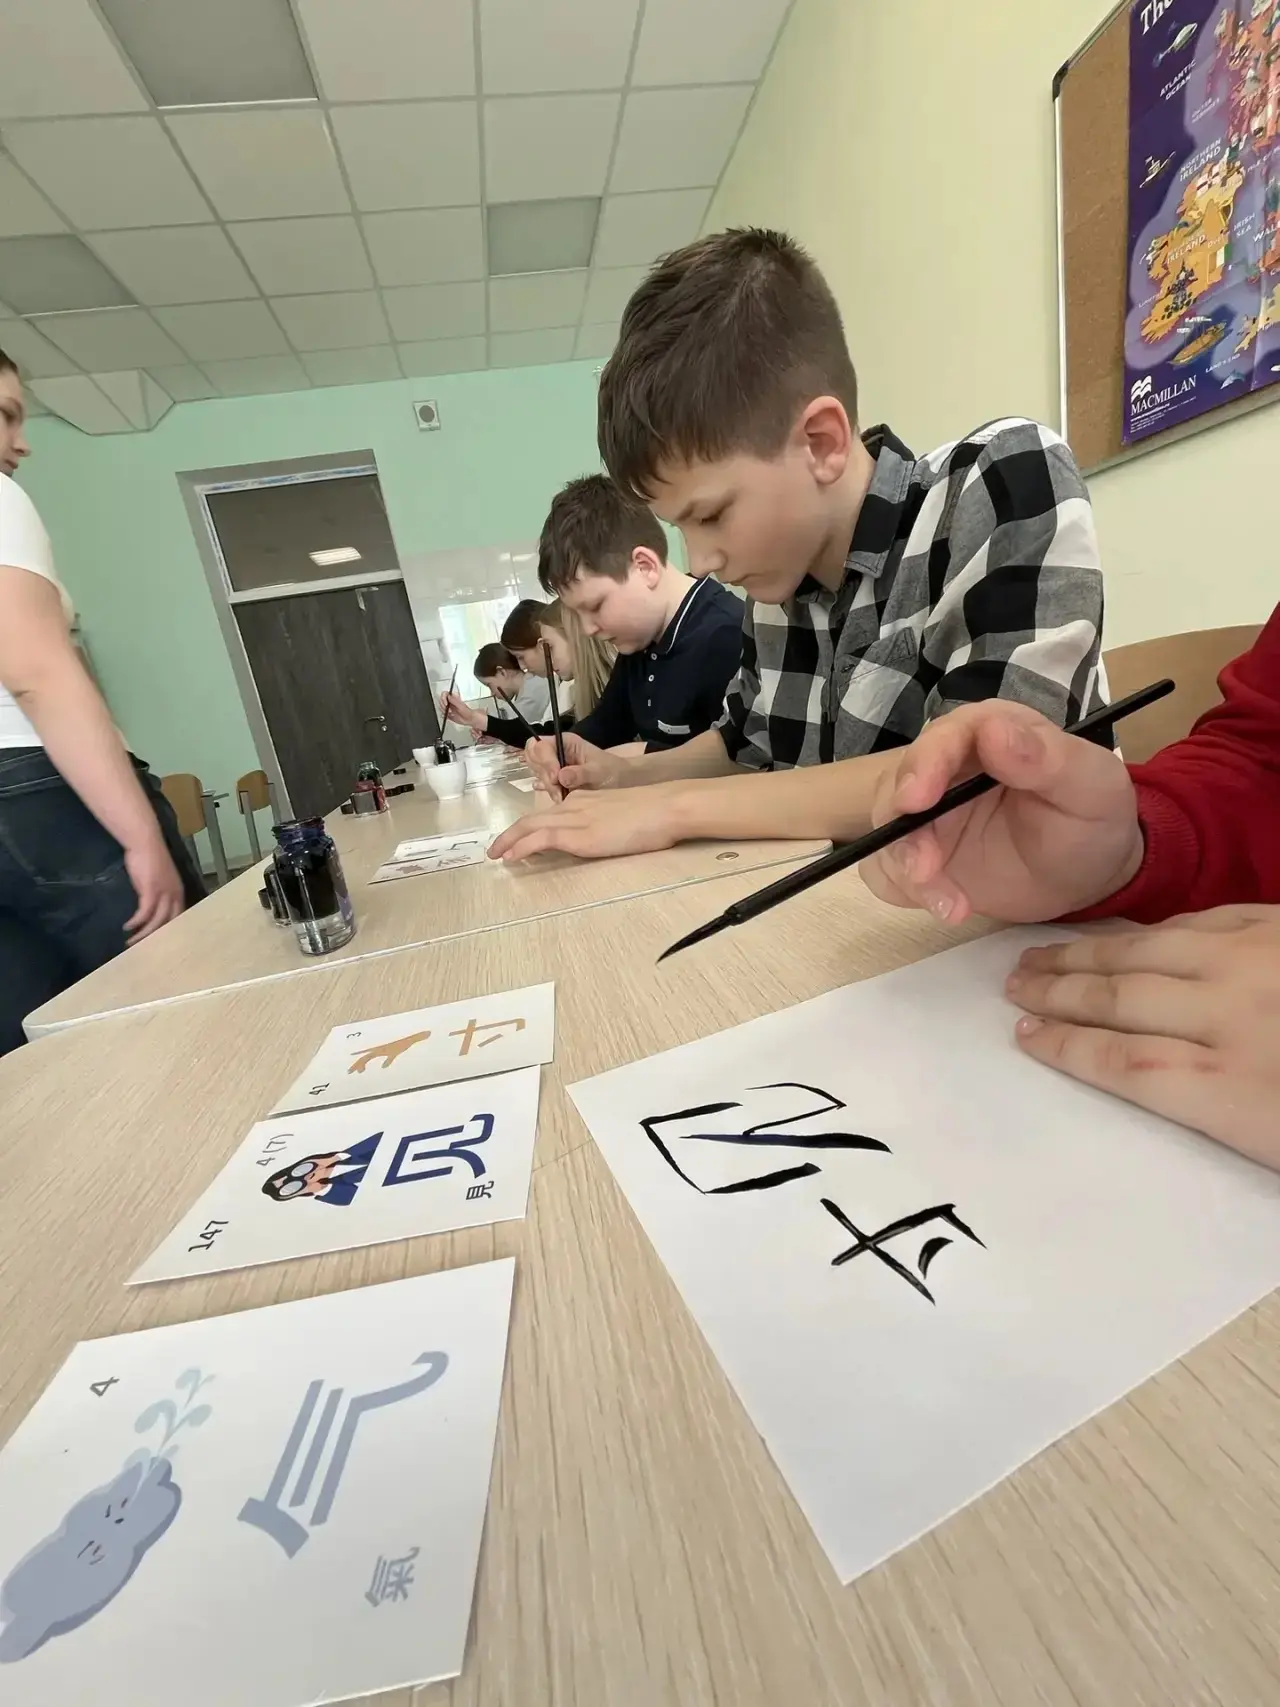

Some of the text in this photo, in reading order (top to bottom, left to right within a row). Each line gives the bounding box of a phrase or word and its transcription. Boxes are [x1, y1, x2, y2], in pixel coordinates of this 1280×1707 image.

[1160, 59, 1197, 97] ATLANTIC
[1165, 74, 1192, 101] OCEAN
[1179, 138, 1221, 174] NORTHERN
[1179, 147, 1221, 182] IRELAND
[1167, 233, 1207, 264] IRELAND
[1253, 220, 1280, 242] WAL
[1130, 375, 1197, 417] MACMILLAN
[448, 1018, 526, 1056] 寸
[308, 1082, 330, 1096] 41
[382, 1113, 495, 1187] 见
[465, 1180, 495, 1201] 見
[187, 1219, 229, 1253] 147
[89, 1376, 120, 1397] 4
[236, 1350, 450, 1560] 气
[364, 1546, 421, 1608] 氣
